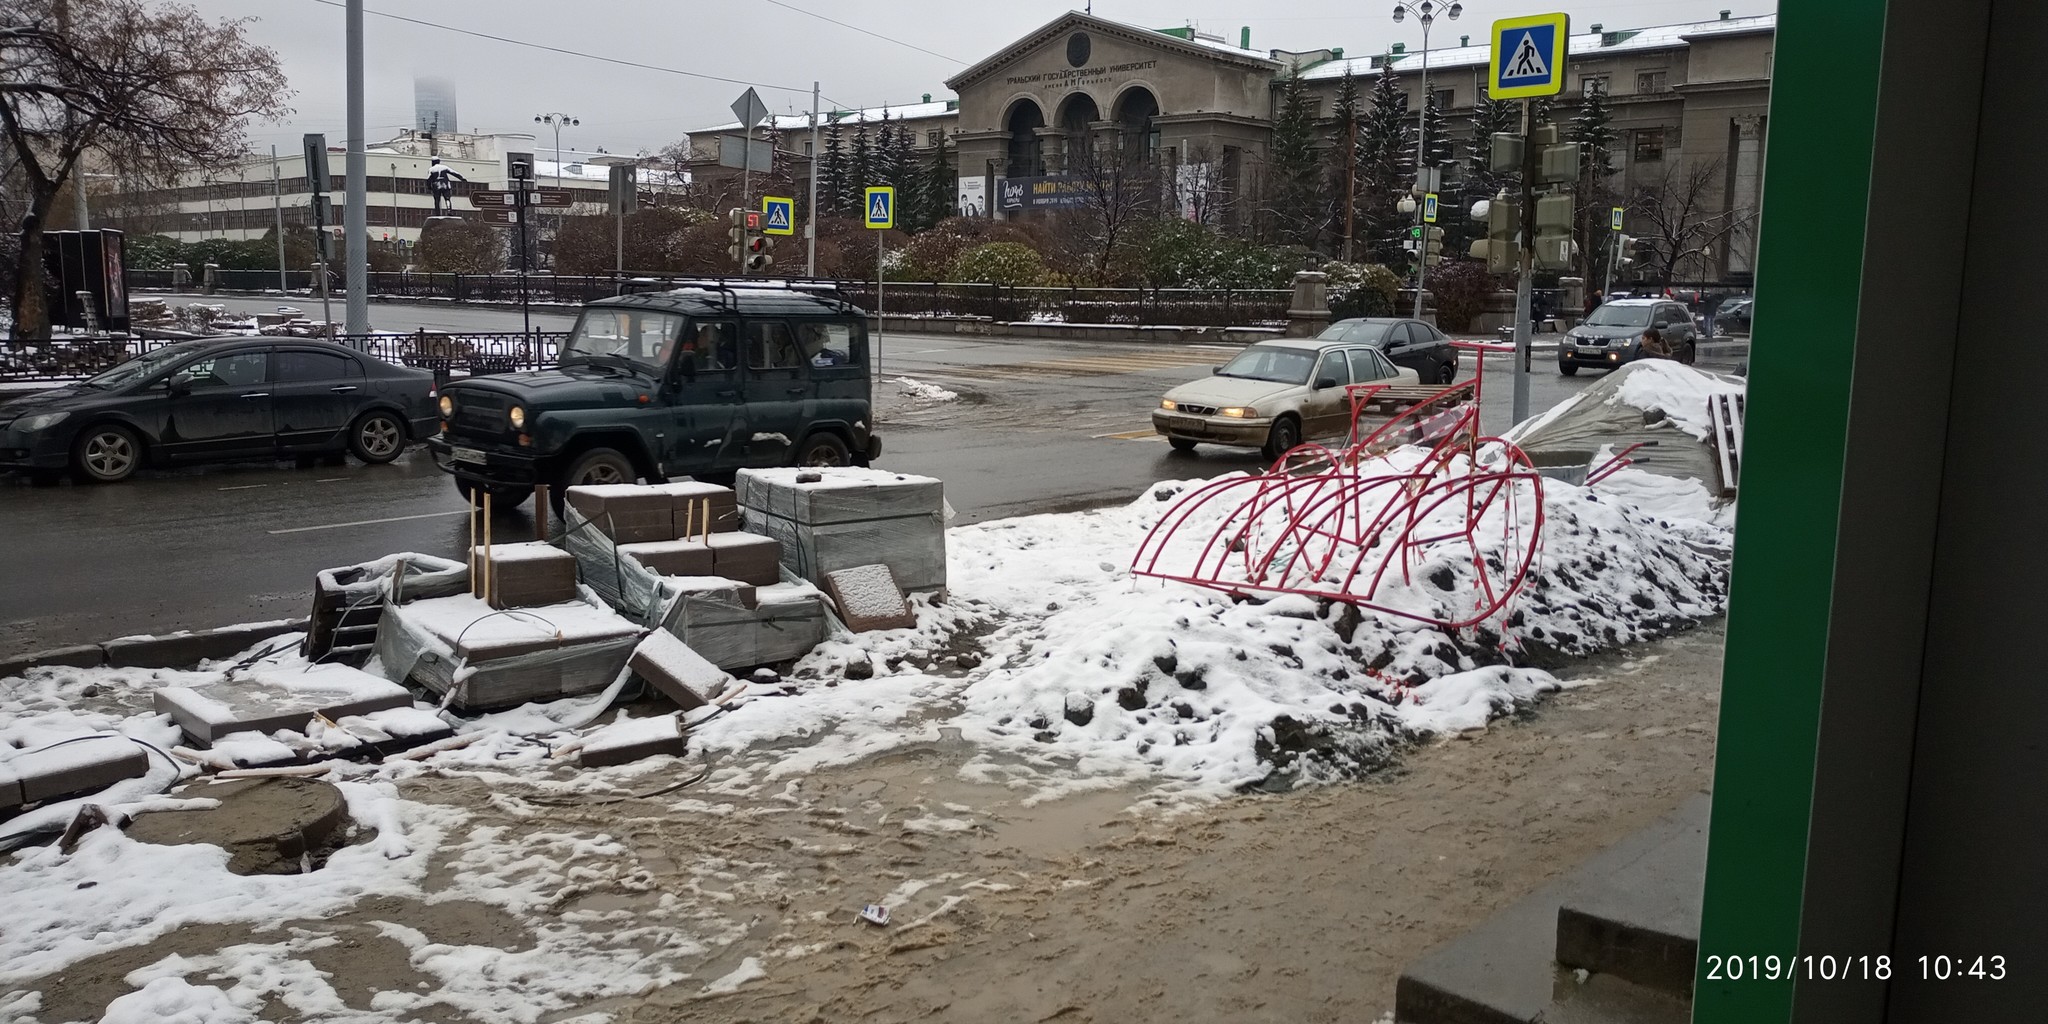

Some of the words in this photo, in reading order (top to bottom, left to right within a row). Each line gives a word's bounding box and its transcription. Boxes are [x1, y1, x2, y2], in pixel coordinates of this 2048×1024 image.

[1006, 74, 1041, 85] УРАЛЬСКИЙ
[1043, 66, 1107, 81] ГОСУДАРСТВЕННЫЙ
[1109, 60, 1158, 73] УНИВЕРСИТЕТ
[1032, 181, 1056, 195] НАЙТИ
